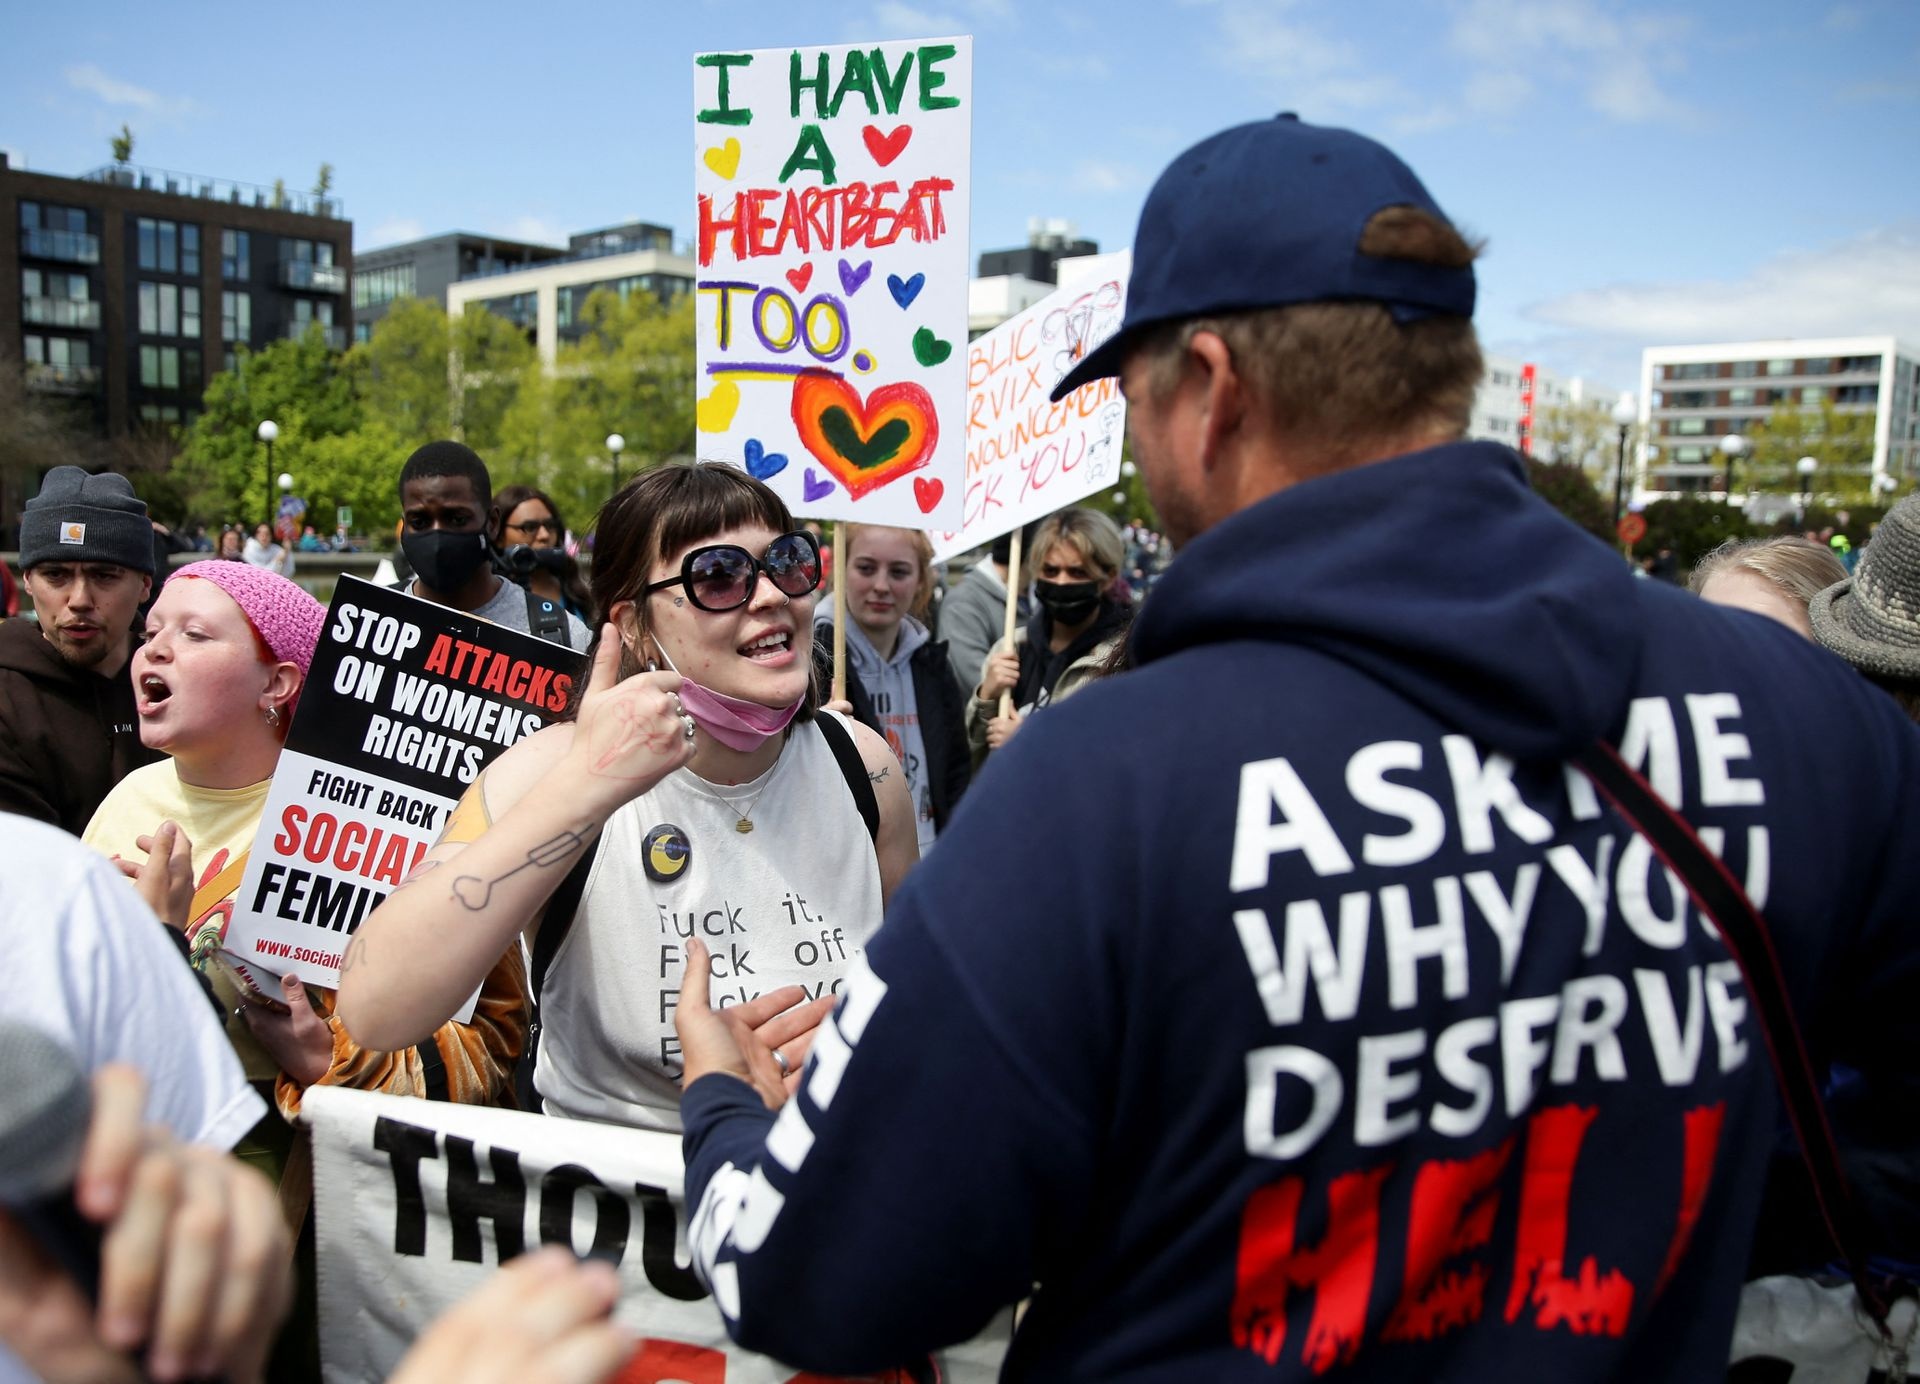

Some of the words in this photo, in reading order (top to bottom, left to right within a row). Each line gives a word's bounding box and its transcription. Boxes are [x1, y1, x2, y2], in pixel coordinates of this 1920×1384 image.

[696, 53, 753, 125] I
[789, 44, 961, 119] HAVE
[778, 124, 837, 185] A
[697, 176, 954, 267] HEARTBEAT
[697, 280, 878, 376] TOO.
[1020, 431, 1086, 503] YOU
[331, 603, 421, 662] STOP
[423, 634, 573, 713] ATTACKS
[334, 655, 386, 704] ON
[390, 671, 542, 748] WOMENS
[362, 715, 484, 784] RIGHTS
[307, 770, 374, 810] FIGHT
[377, 794, 439, 831] BACK
[1229, 733, 1554, 893] ASK
[251, 862, 387, 936] FEMI
[656, 900, 748, 938] Fuck
[781, 893, 823, 926] it.
[1232, 862, 1542, 1027] WHY
[1545, 825, 1770, 958] YOU
[660, 943, 756, 979] Fck
[1243, 961, 1749, 1160] DESERVE
